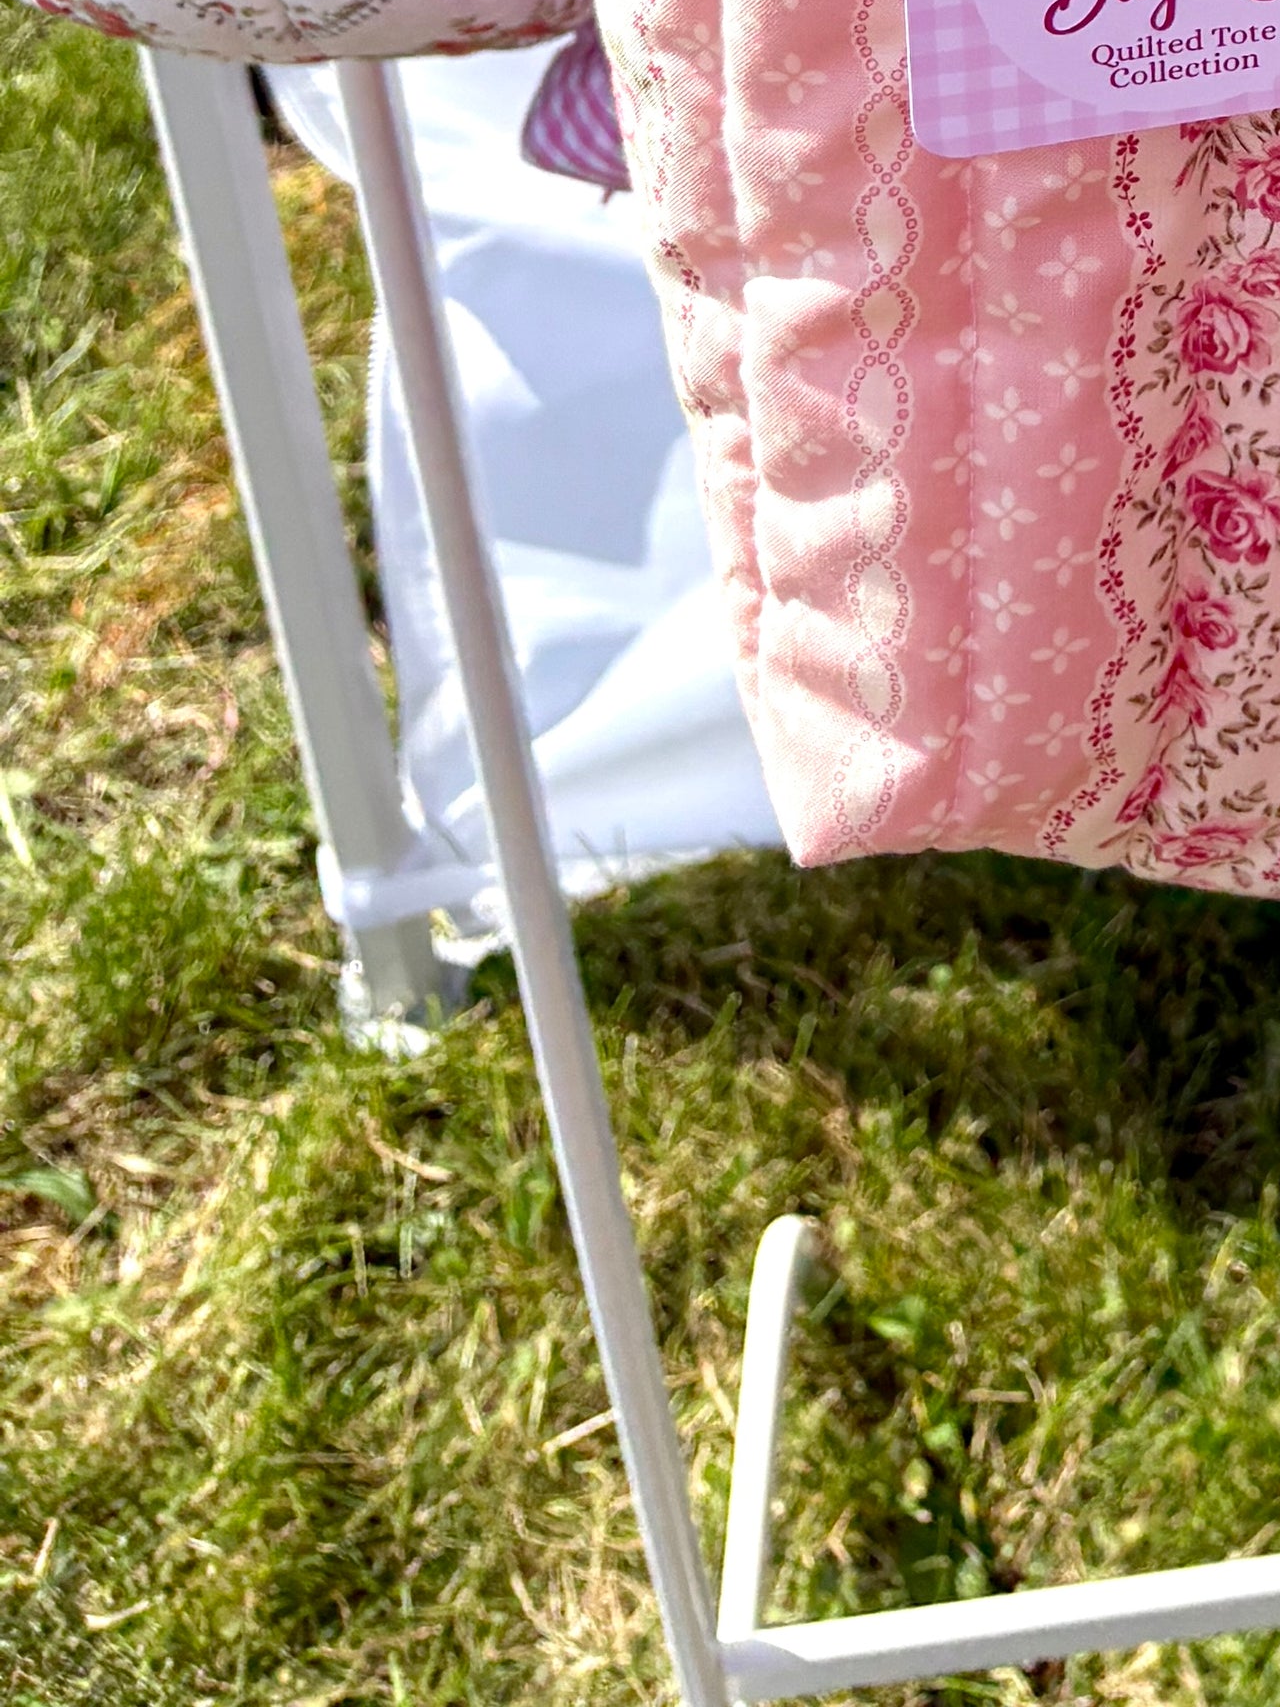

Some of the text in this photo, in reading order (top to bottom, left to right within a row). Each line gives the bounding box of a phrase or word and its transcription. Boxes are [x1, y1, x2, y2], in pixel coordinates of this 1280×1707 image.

[1091, 22, 1277, 67] Quilted Tote
[1109, 51, 1260, 89] Collection
